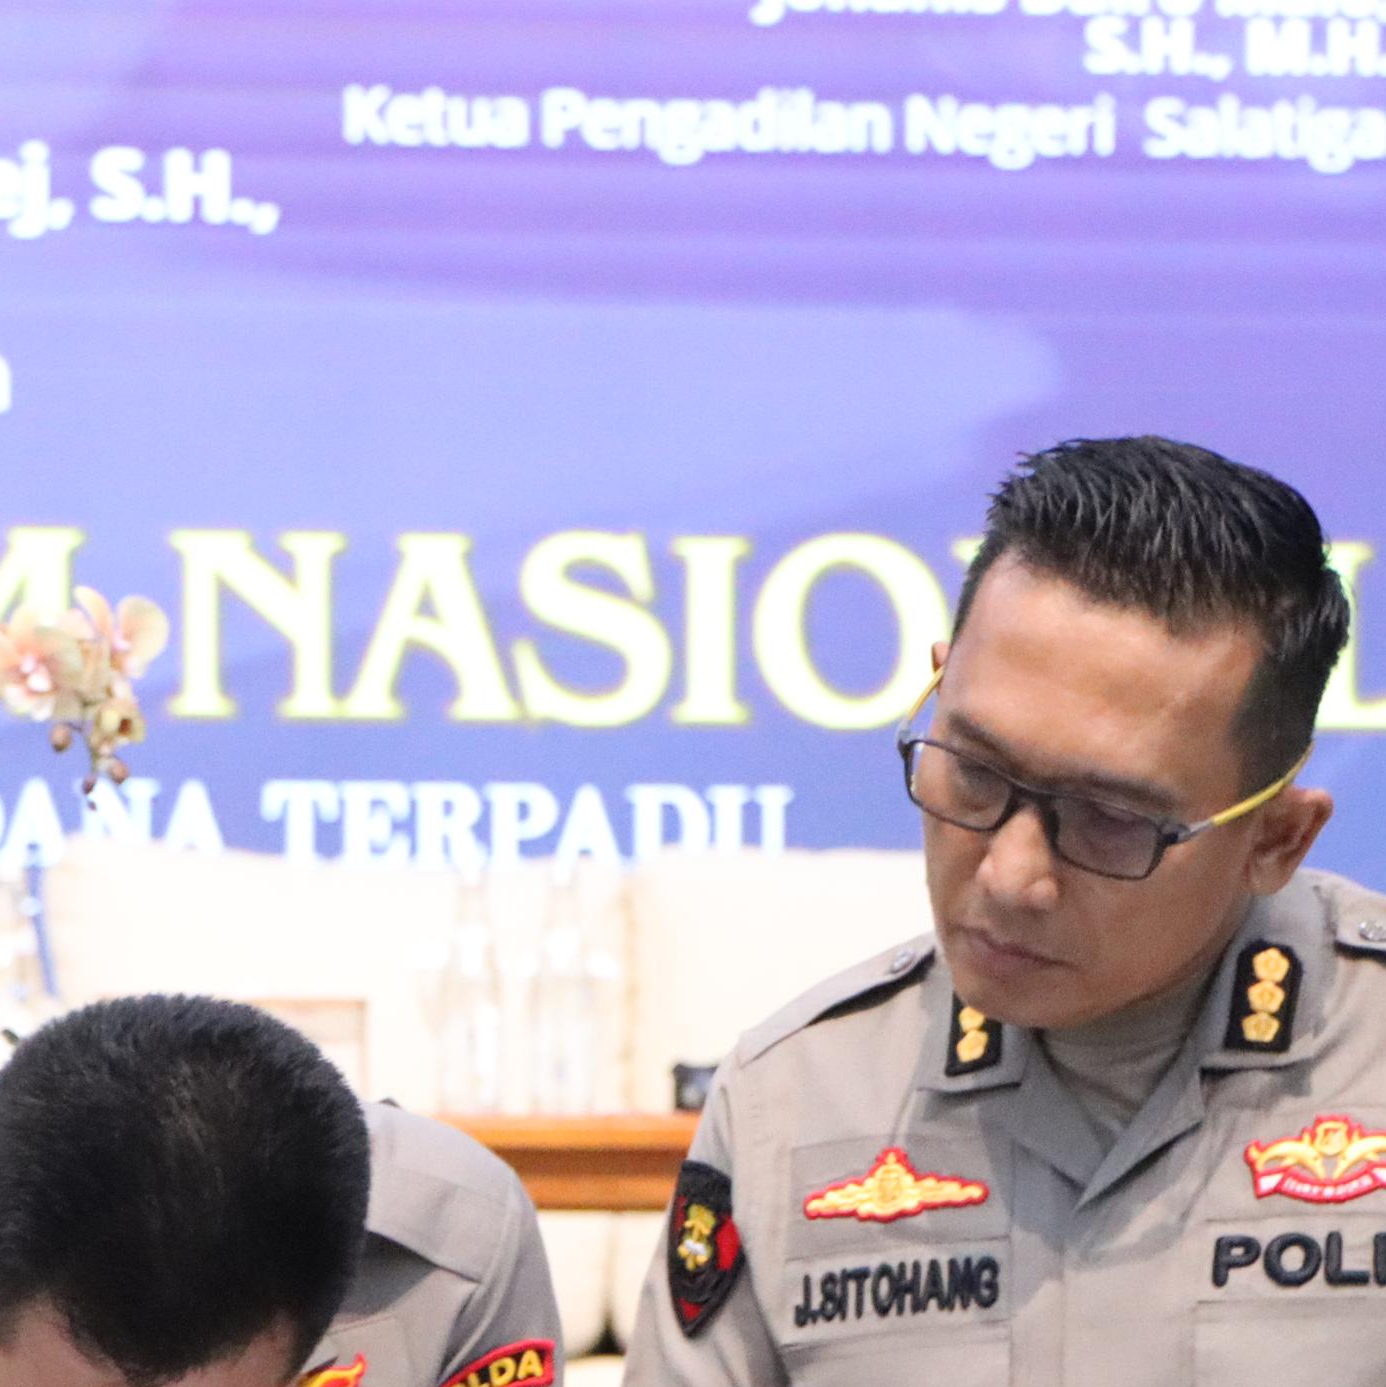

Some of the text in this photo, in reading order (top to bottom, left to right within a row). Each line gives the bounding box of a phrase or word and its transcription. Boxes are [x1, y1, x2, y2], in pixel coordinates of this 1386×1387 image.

[1083, 15, 1233, 80] S.H.,
[342, 85, 531, 147] Ketua
[541, 88, 893, 166] Pengadilan
[905, 93, 1116, 170] Negeri
[90, 145, 280, 234] S.H.,
[260, 779, 795, 870] TERPADU
[794, 1255, 1000, 1328] J.SITOHANG
